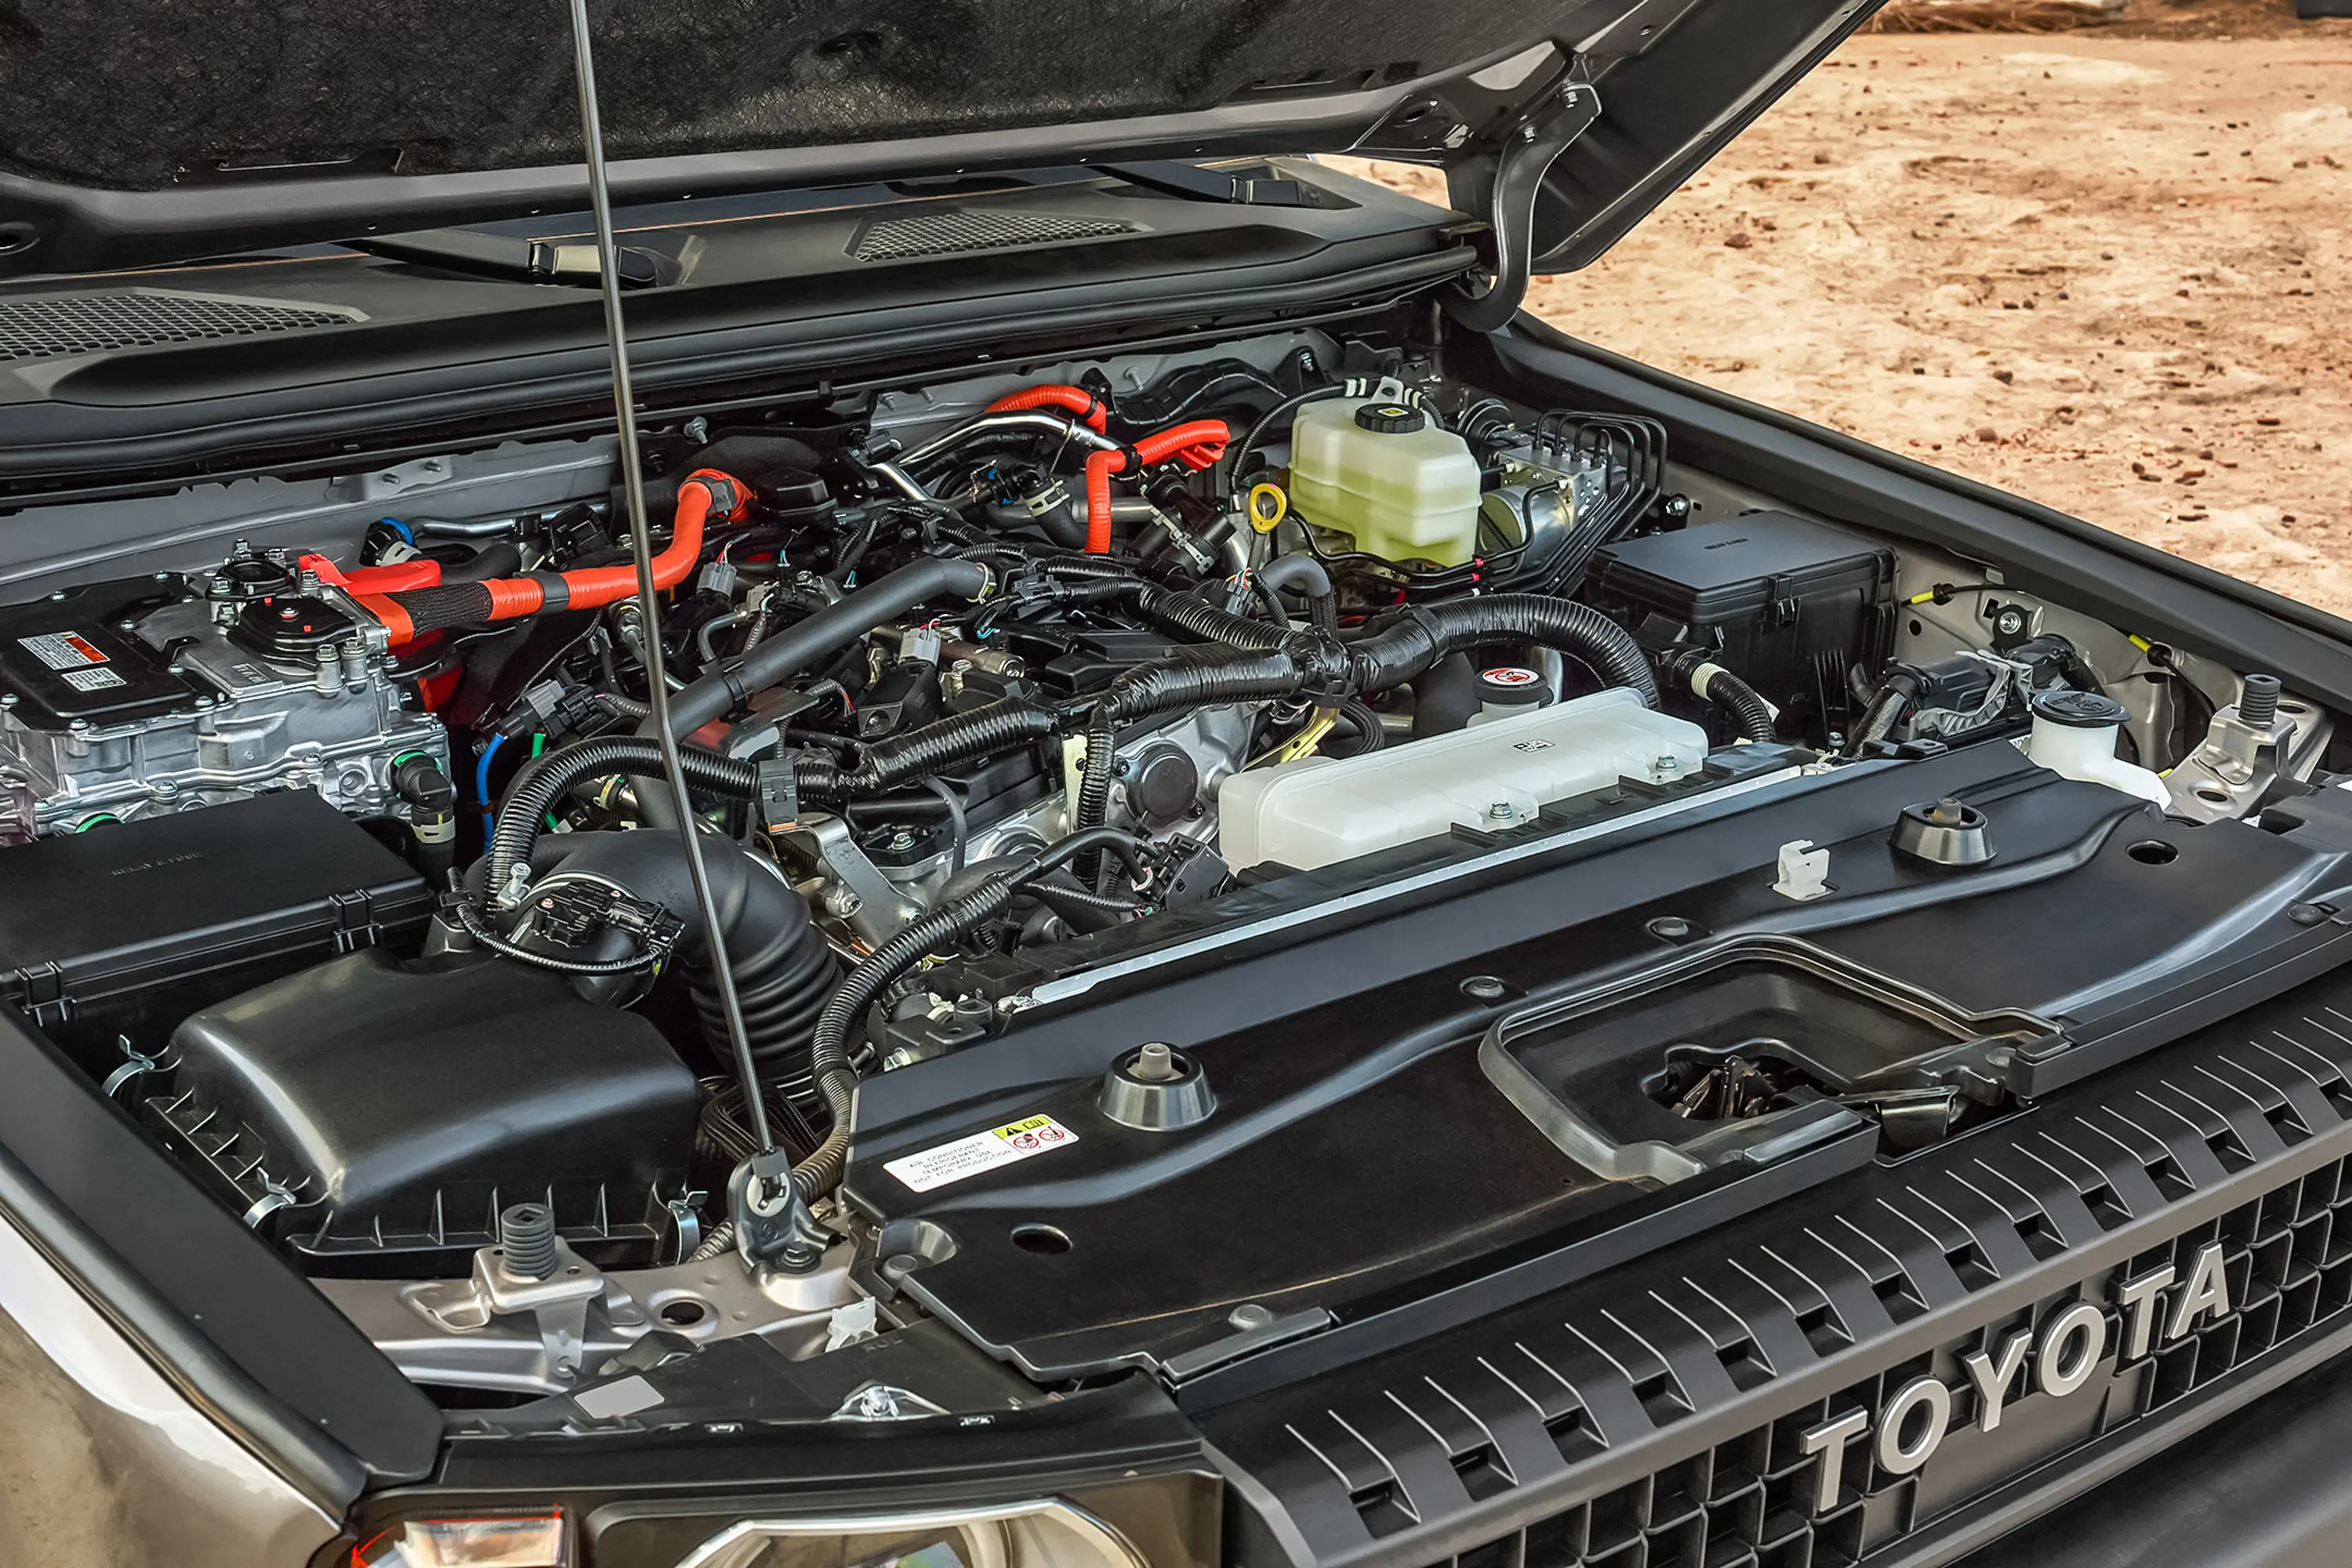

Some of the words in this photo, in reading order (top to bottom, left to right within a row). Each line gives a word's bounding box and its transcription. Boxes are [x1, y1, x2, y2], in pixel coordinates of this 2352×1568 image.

[909, 1160, 924, 1169] AIR
[927, 1141, 985, 1163] CONDITIONER
[1802, 1241, 2230, 1512] TOYOTA
